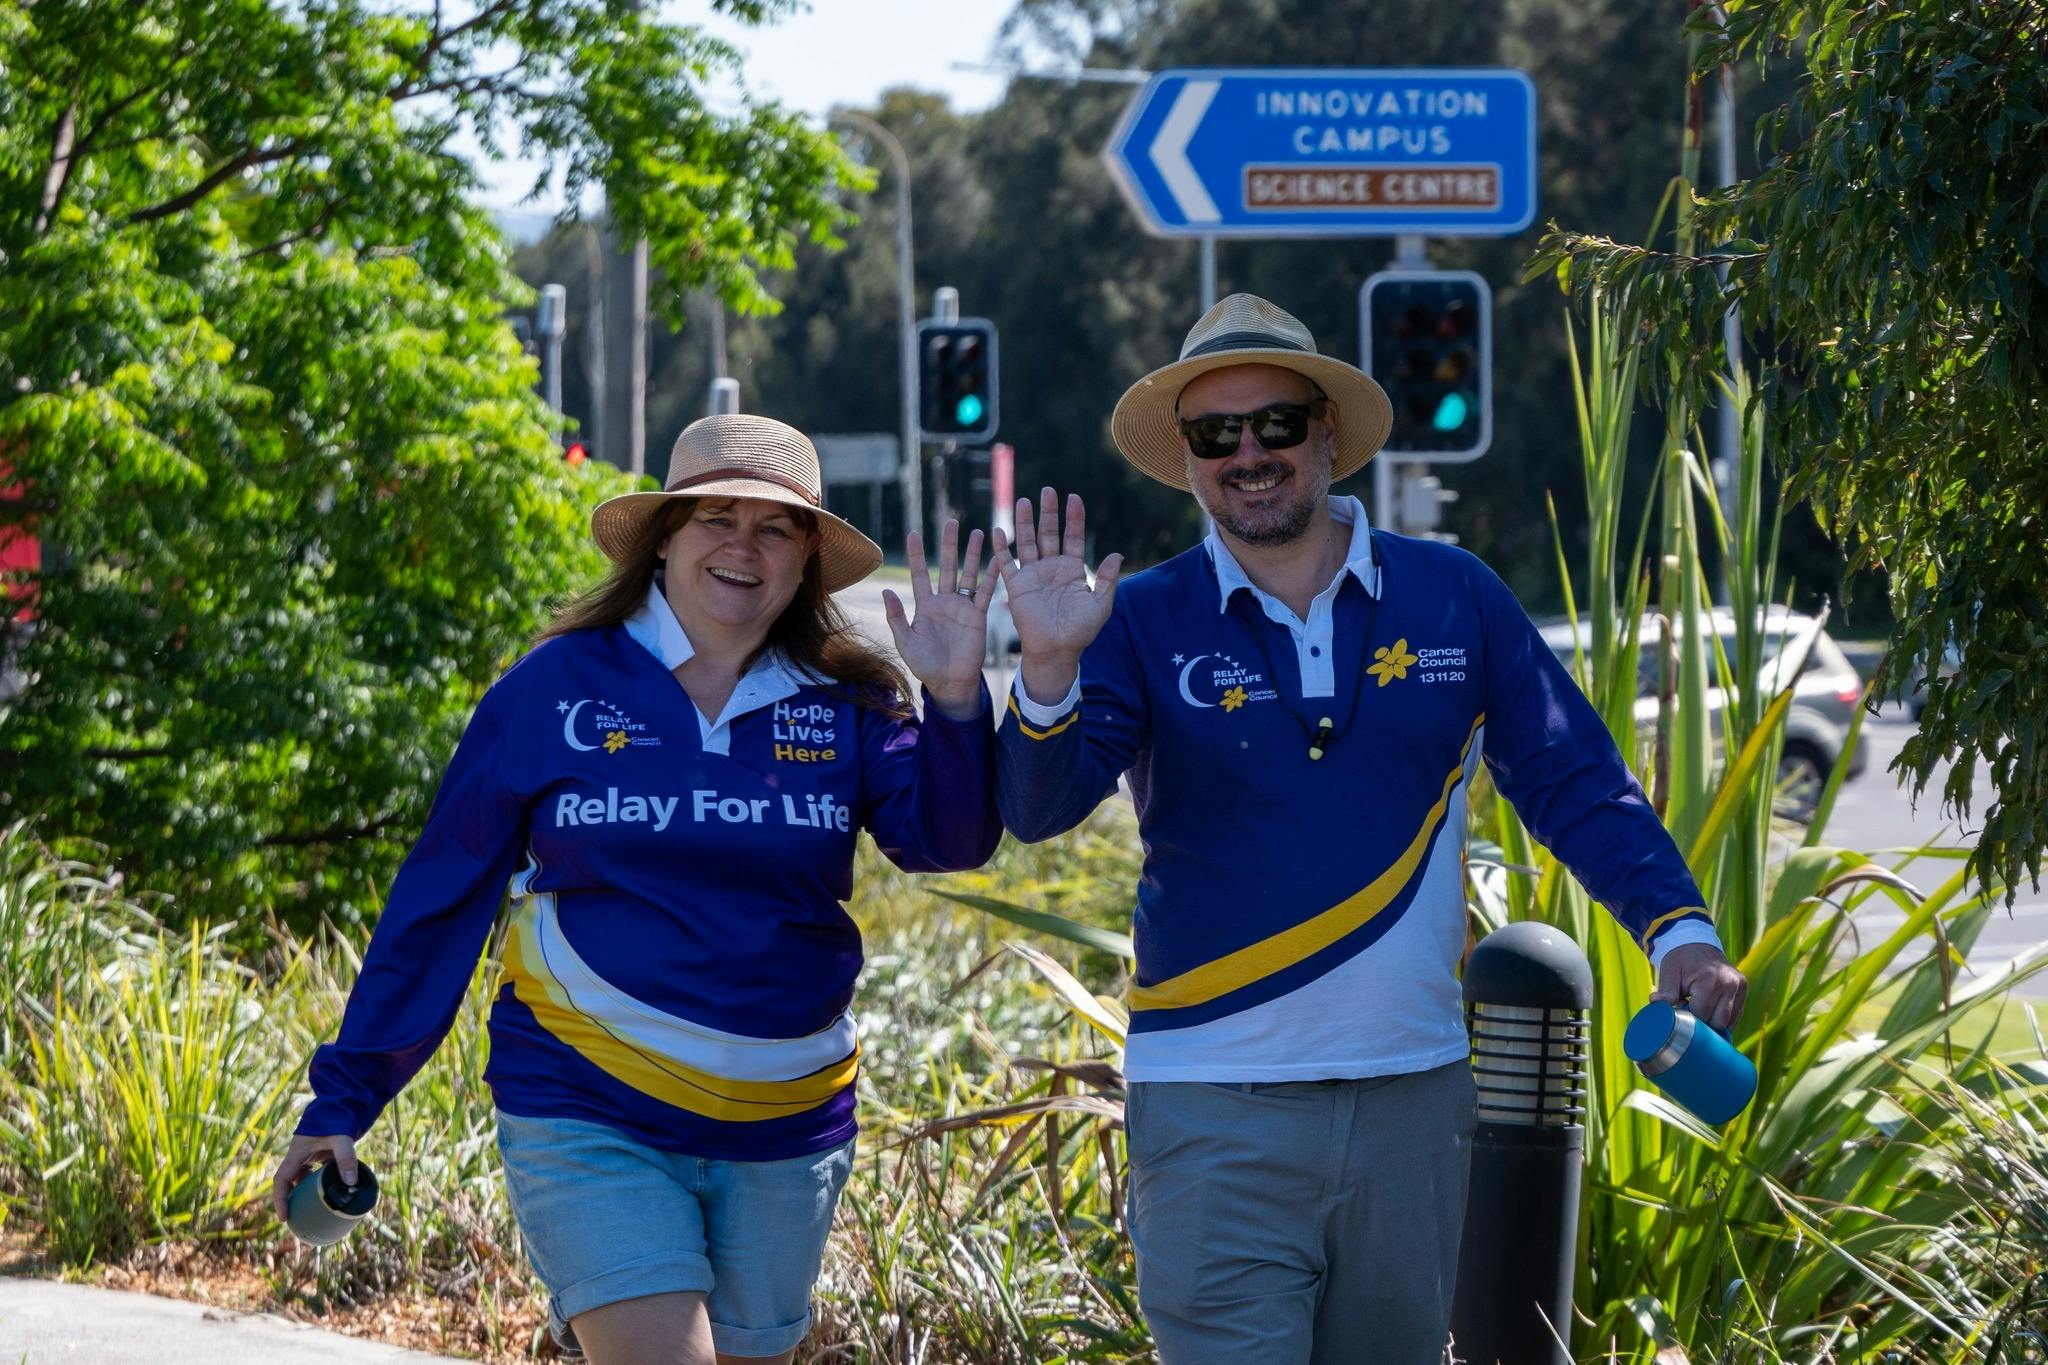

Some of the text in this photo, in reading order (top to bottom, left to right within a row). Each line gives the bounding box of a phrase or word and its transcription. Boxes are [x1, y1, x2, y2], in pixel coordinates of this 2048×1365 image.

[1256, 89, 1489, 118] INNOVATION
[1293, 125, 1451, 154] CAMPUS
[1251, 172, 1495, 203] SCIENCE CENTRE
[1418, 648, 1466, 658] Cancer
[1419, 656, 1467, 668] Council
[1213, 668, 1247, 678] RELAY
[1214, 674, 1262, 687] FOR LIFE
[595, 714, 631, 724] RELAY
[773, 701, 835, 725] Hope
[596, 721, 646, 731] FOR LIFE
[773, 719, 836, 743] Lives
[775, 743, 836, 762] Here
[555, 787, 850, 833] Relay For Life
